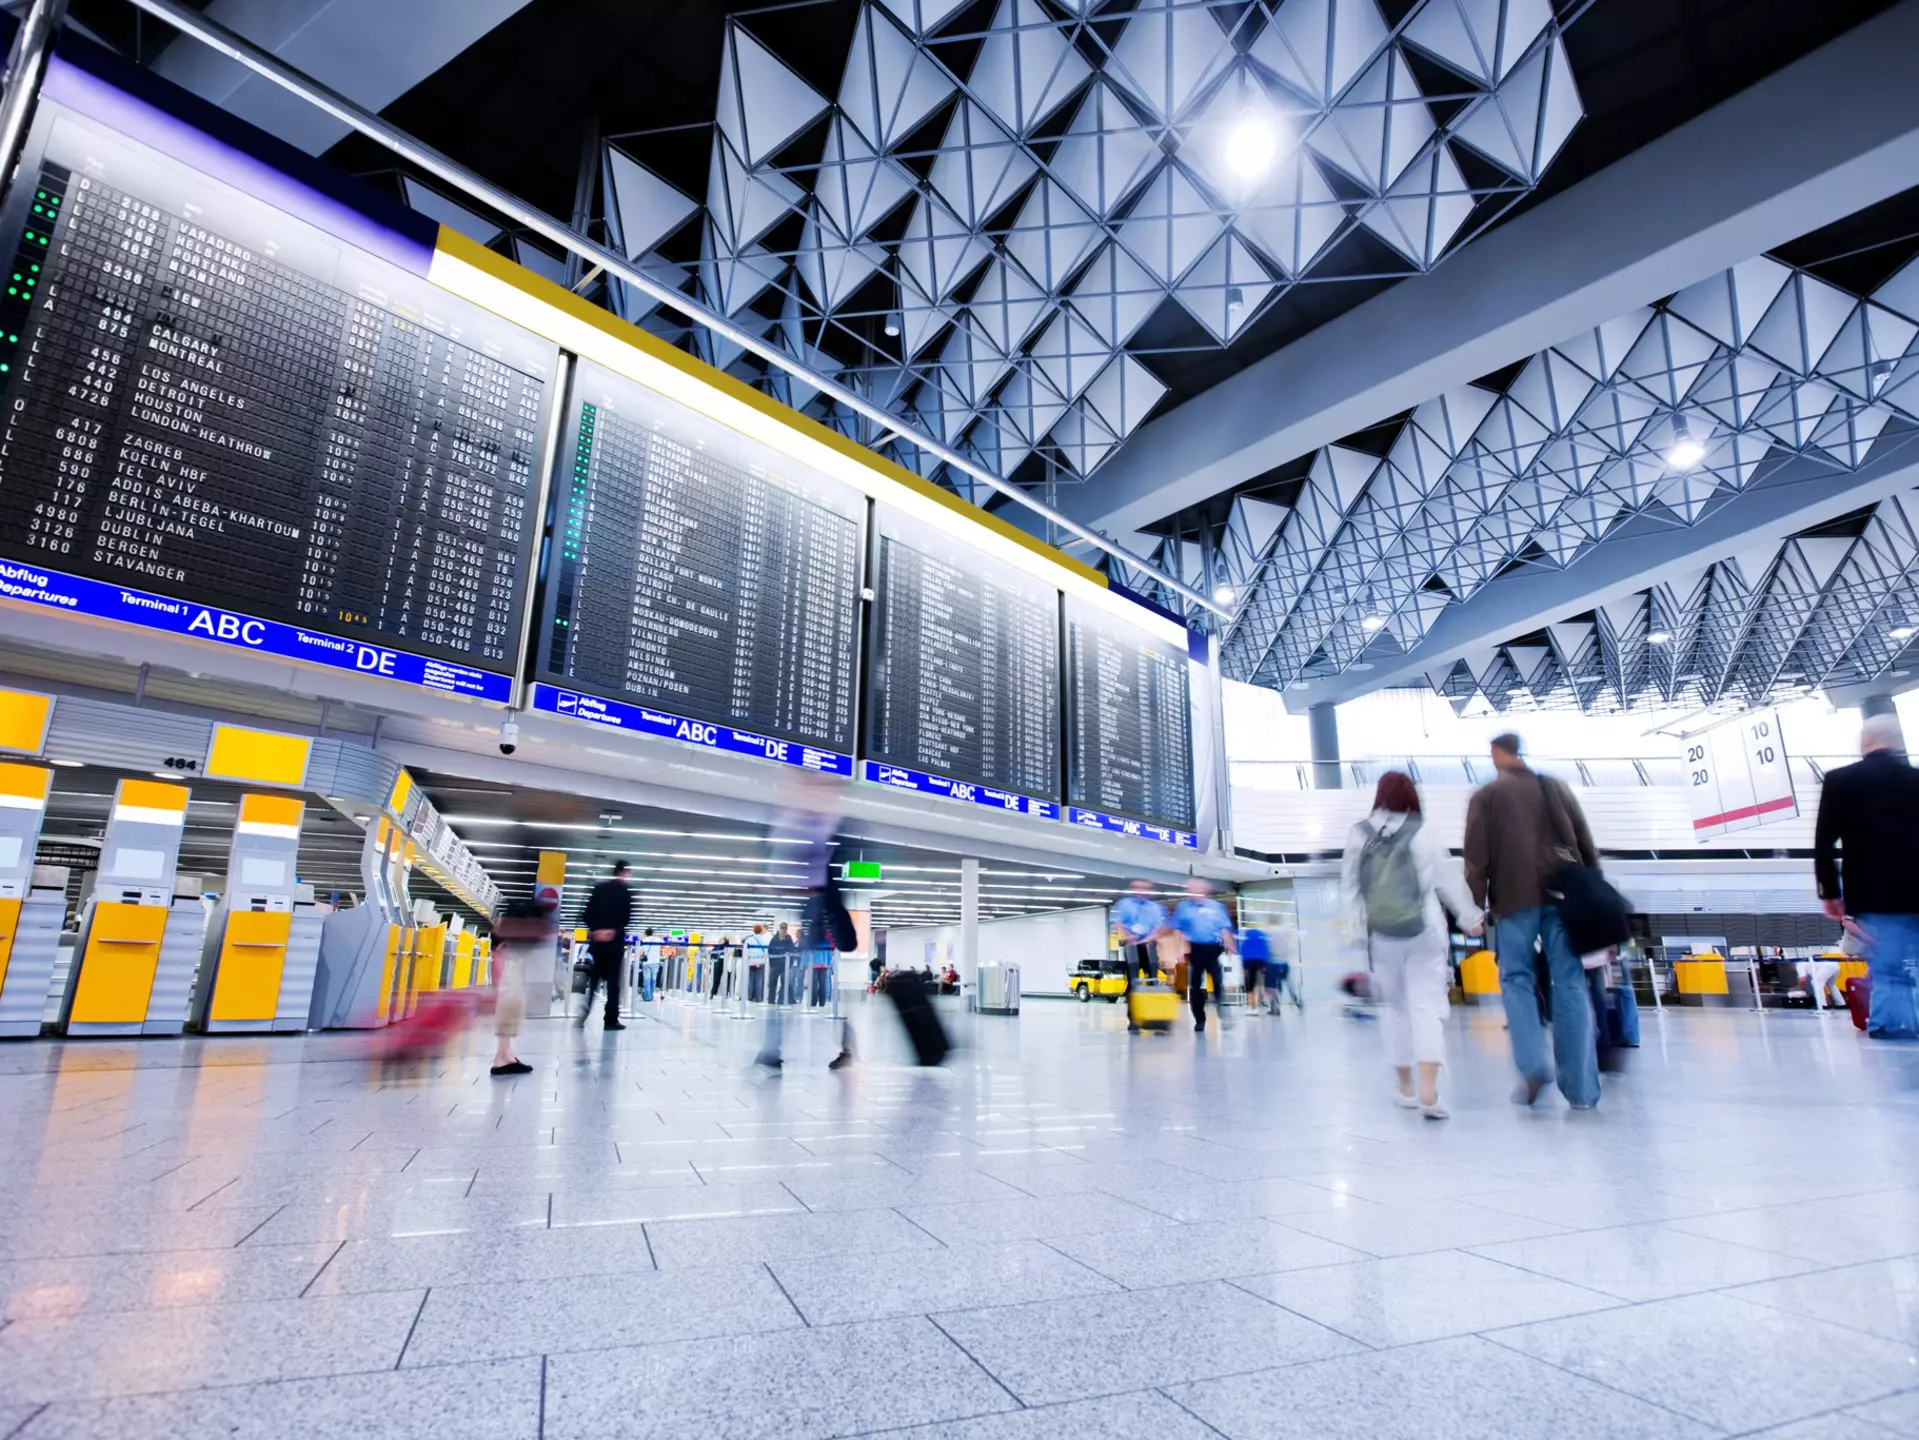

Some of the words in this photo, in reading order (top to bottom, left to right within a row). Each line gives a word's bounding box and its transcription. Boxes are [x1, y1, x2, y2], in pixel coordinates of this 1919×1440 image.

[117, 209, 157, 234] 3102
[175, 235, 247, 273] HELSINKI
[121, 196, 160, 221] 2188
[179, 222, 250, 261] VARADERO
[102, 261, 143, 285] 3236
[169, 260, 215, 286] MIAMI
[172, 247, 244, 285] PORTLAND
[101, 305, 132, 324] 494
[152, 324, 218, 357] CALGARY
[98, 319, 128, 338] 875
[148, 338, 224, 373] MONTREAL
[86, 360, 117, 379] 442
[138, 378, 205, 409] DETROIT
[90, 346, 121, 365] 456
[141, 364, 171, 383] LOS
[180, 378, 244, 409] ANGELES
[82, 374, 114, 393] 440
[134, 392, 202, 423] HOUSTON
[67, 384, 110, 407] 4726
[130, 406, 271, 460] LONDON-HEATHROW
[70, 417, 102, 435] 417
[123, 434, 183, 460] ZAGREB
[55, 428, 98, 450] 6808
[119, 448, 170, 471] KOELN
[179, 466, 208, 483] HBF
[62, 446, 94, 464] 686
[115, 462, 146, 480] TEL
[156, 474, 195, 494] AVIV
[53, 476, 86, 494] 176
[108, 491, 226, 532] BERLIN-TEGEL
[57, 461, 90, 479] 590
[112, 476, 163, 500] ADDIS
[172, 494, 300, 539] ABEBA-KHARTOUM
[33, 503, 78, 524] 4980
[100, 521, 162, 546] DUBLIN
[49, 491, 82, 509] 117
[104, 506, 195, 539] LJUBLJANA
[29, 518, 74, 539] 3126
[96, 535, 159, 560] BERGEN
[640, 543, 675, 562] KOLKATA
[662, 540, 681, 554] YORK
[24, 534, 70, 554] 3160
[92, 550, 185, 582] STAVANGER
[0, 564, 48, 587] Abflug
[637, 574, 672, 593] DETROIT
[638, 564, 673, 583] CHICAGO
[636, 585, 661, 600] PARIS
[118, 591, 179, 614] Terminal
[181, 606, 188, 615] 1
[187, 607, 266, 645] ABC
[295, 631, 345, 650] Terminal
[346, 643, 354, 653] 2
[355, 646, 396, 675] DE
[631, 628, 667, 645] VILNIUS
[628, 650, 670, 668] HELSINKI
[630, 639, 666, 656] TORONTO
[627, 660, 674, 680] AMSTERDAM
[578, 697, 606, 711] Abflug
[625, 683, 657, 698] DUBLIN
[577, 706, 621, 725] Departures
[640, 710, 671, 725] Terminal
[676, 719, 717, 745] ABC
[732, 731, 759, 744] Terminal
[765, 739, 788, 760] DE
[1751, 721, 1770, 740] 10
[164, 757, 196, 770] 464
[1687, 744, 1704, 762] 20
[1756, 746, 1775, 766] 10
[1692, 769, 1709, 786] 20
[950, 781, 975, 800] ABC
[1004, 793, 1019, 810] DE
[1123, 820, 1140, 836] ABC
[1159, 828, 1169, 841] DE
